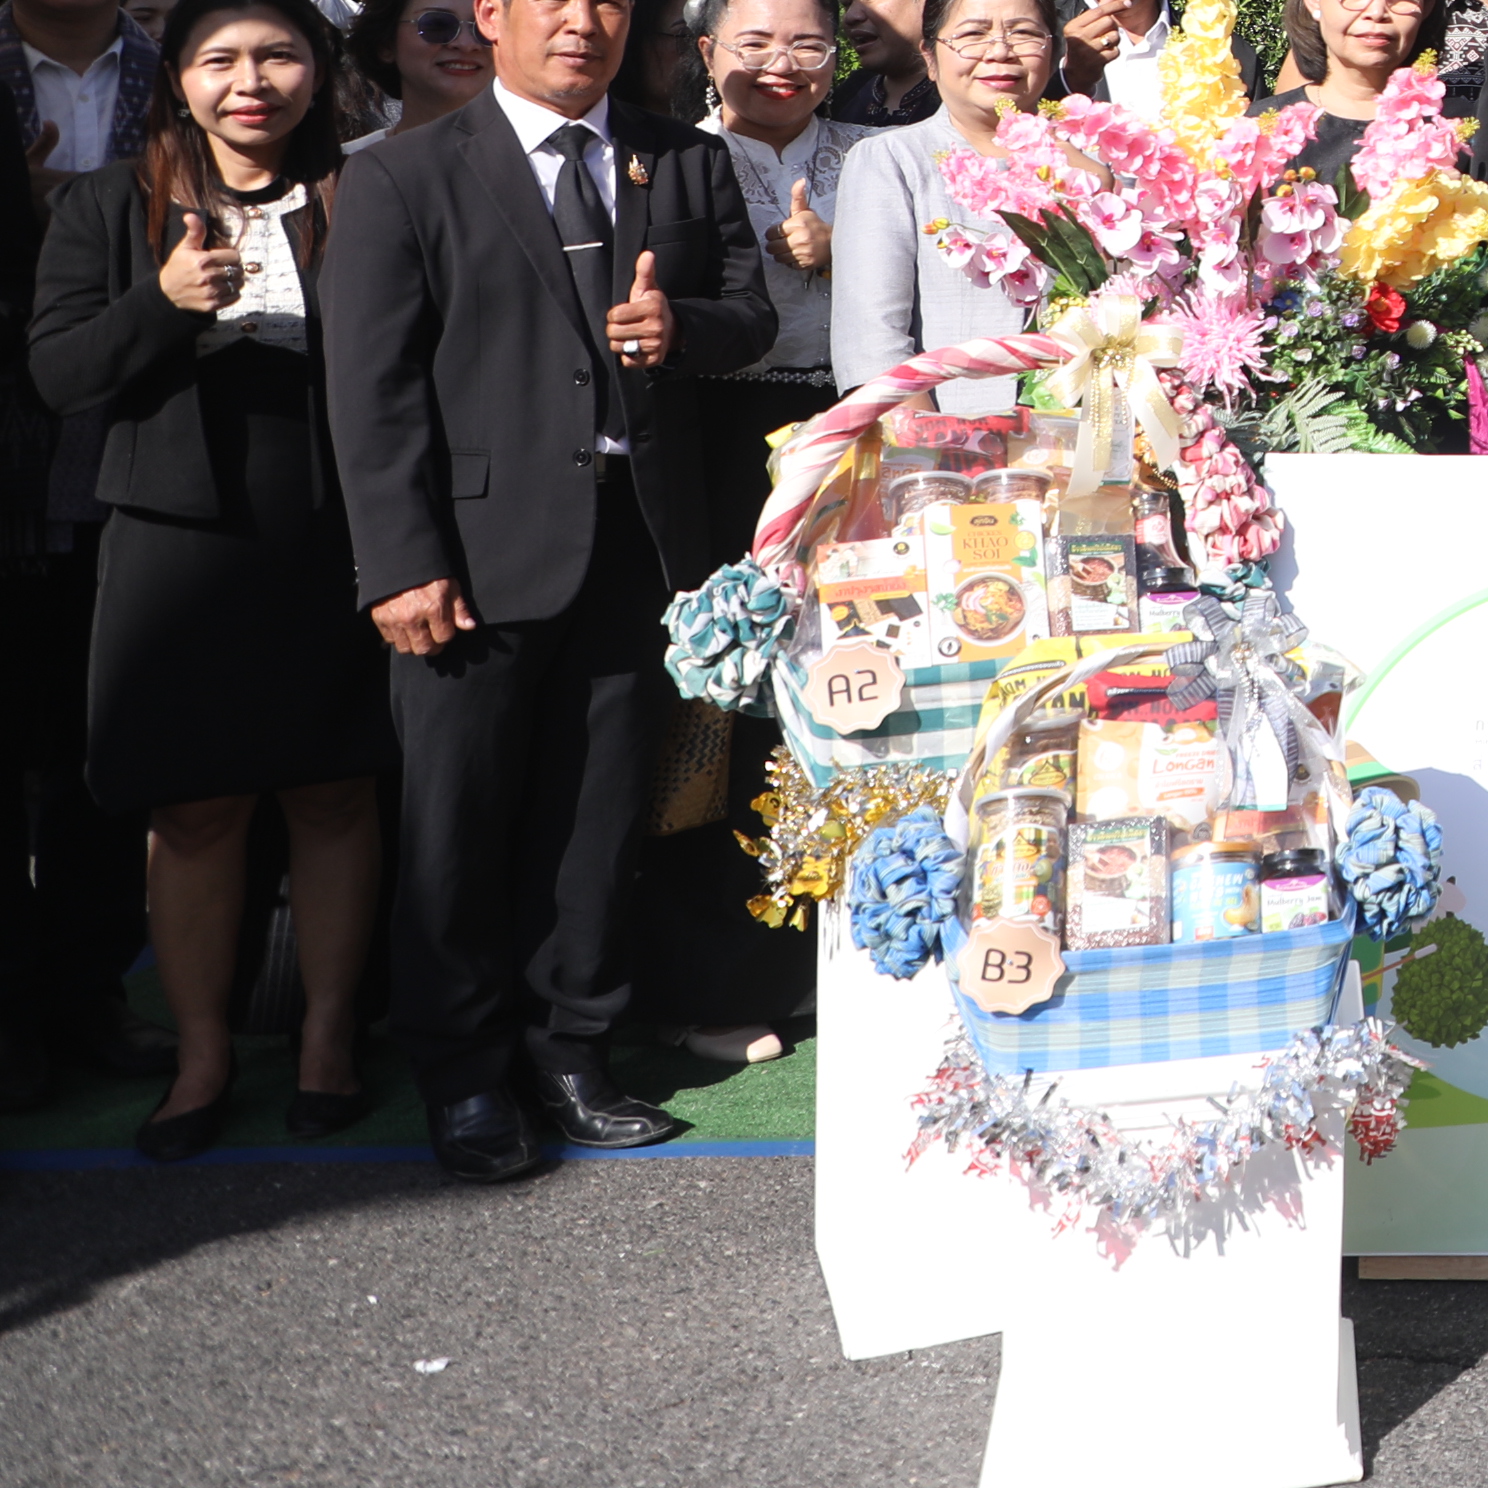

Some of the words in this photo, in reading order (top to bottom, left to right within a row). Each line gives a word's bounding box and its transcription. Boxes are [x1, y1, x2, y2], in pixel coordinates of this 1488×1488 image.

[962, 535, 1009, 550] KHAO
[972, 548, 1001, 560] SOI
[827, 668, 879, 707] A2
[1266, 896, 1304, 907] Mulberry
[1307, 895, 1322, 903] Jam
[980, 947, 1033, 984] B3
